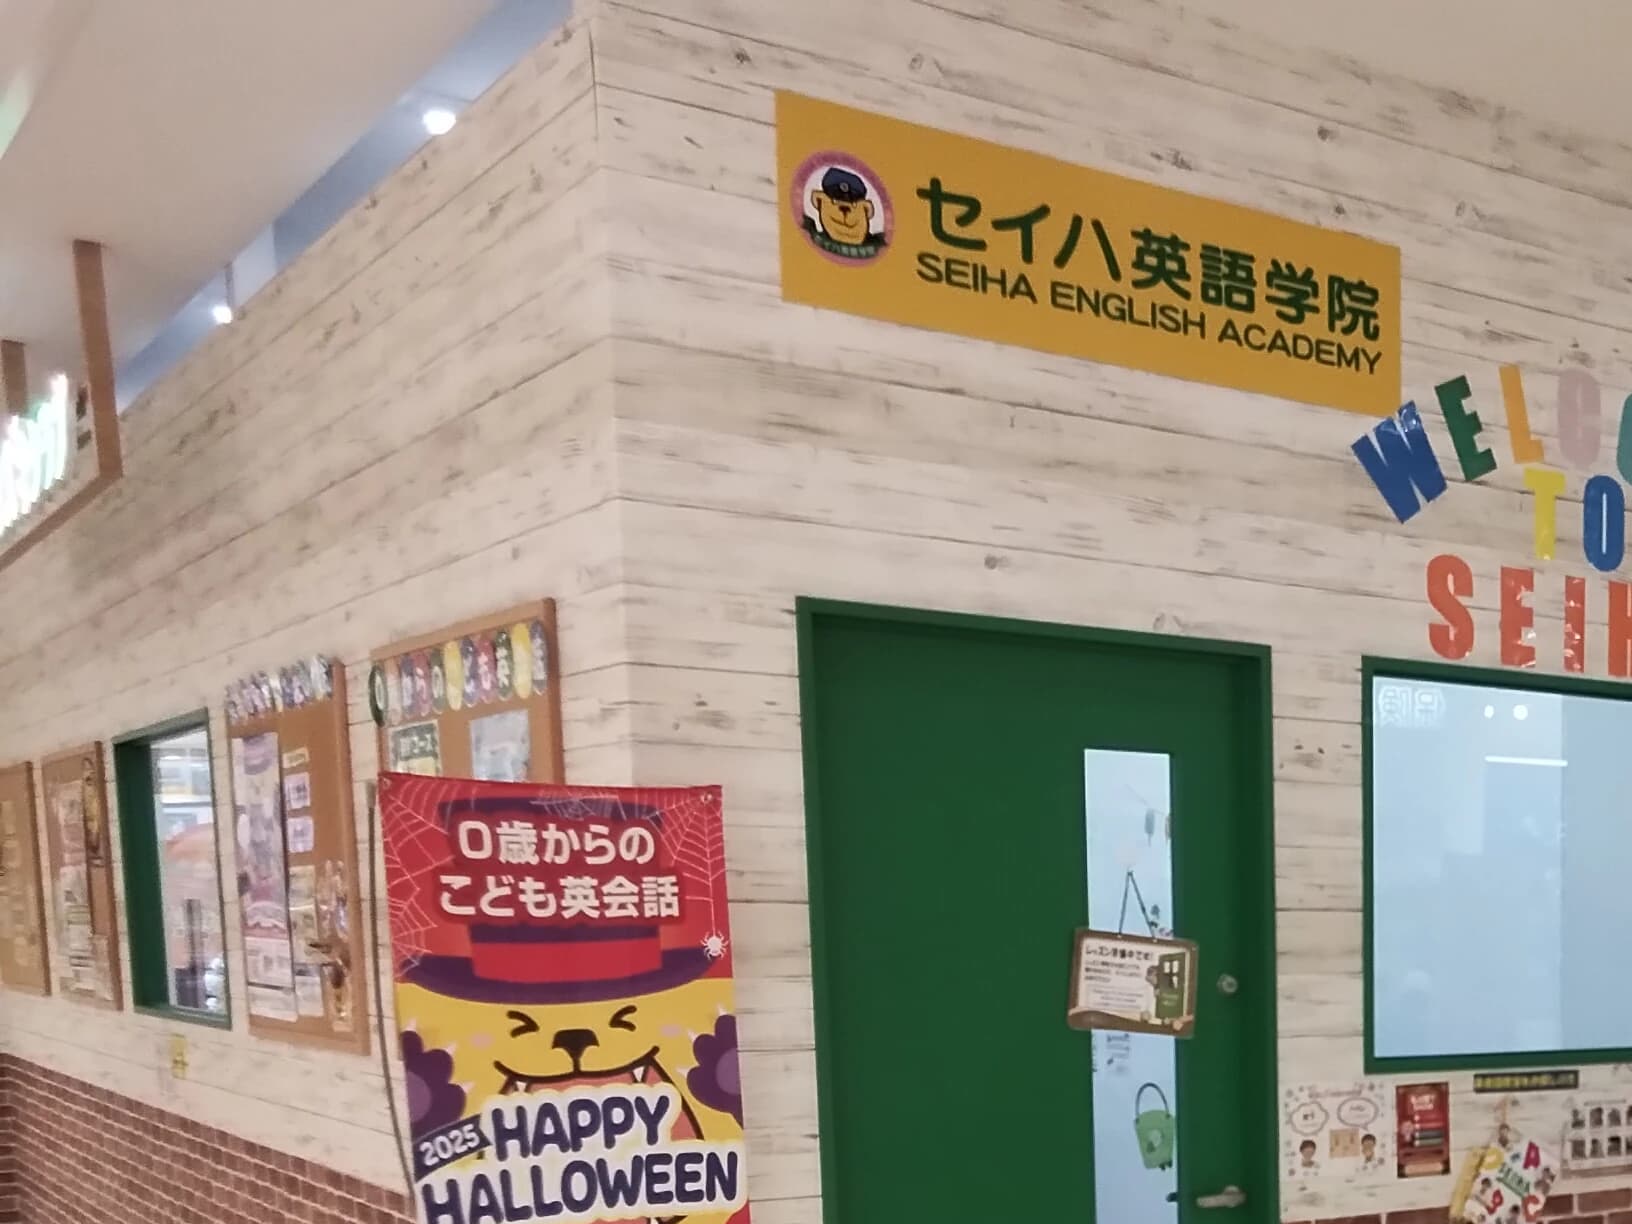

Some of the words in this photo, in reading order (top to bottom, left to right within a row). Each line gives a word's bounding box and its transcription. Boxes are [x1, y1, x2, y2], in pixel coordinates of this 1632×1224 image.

[916, 177, 1380, 341] セイハ英語学院
[916, 252, 1037, 304] SEIHA
[1050, 281, 1206, 339] ENGLISH
[1217, 318, 1383, 375] ACADEMY
[1523, 468, 1625, 572] TO
[438, 874, 680, 919] こども英会話
[419, 1122, 480, 1167] 2025
[491, 1095, 671, 1162] HAPPY
